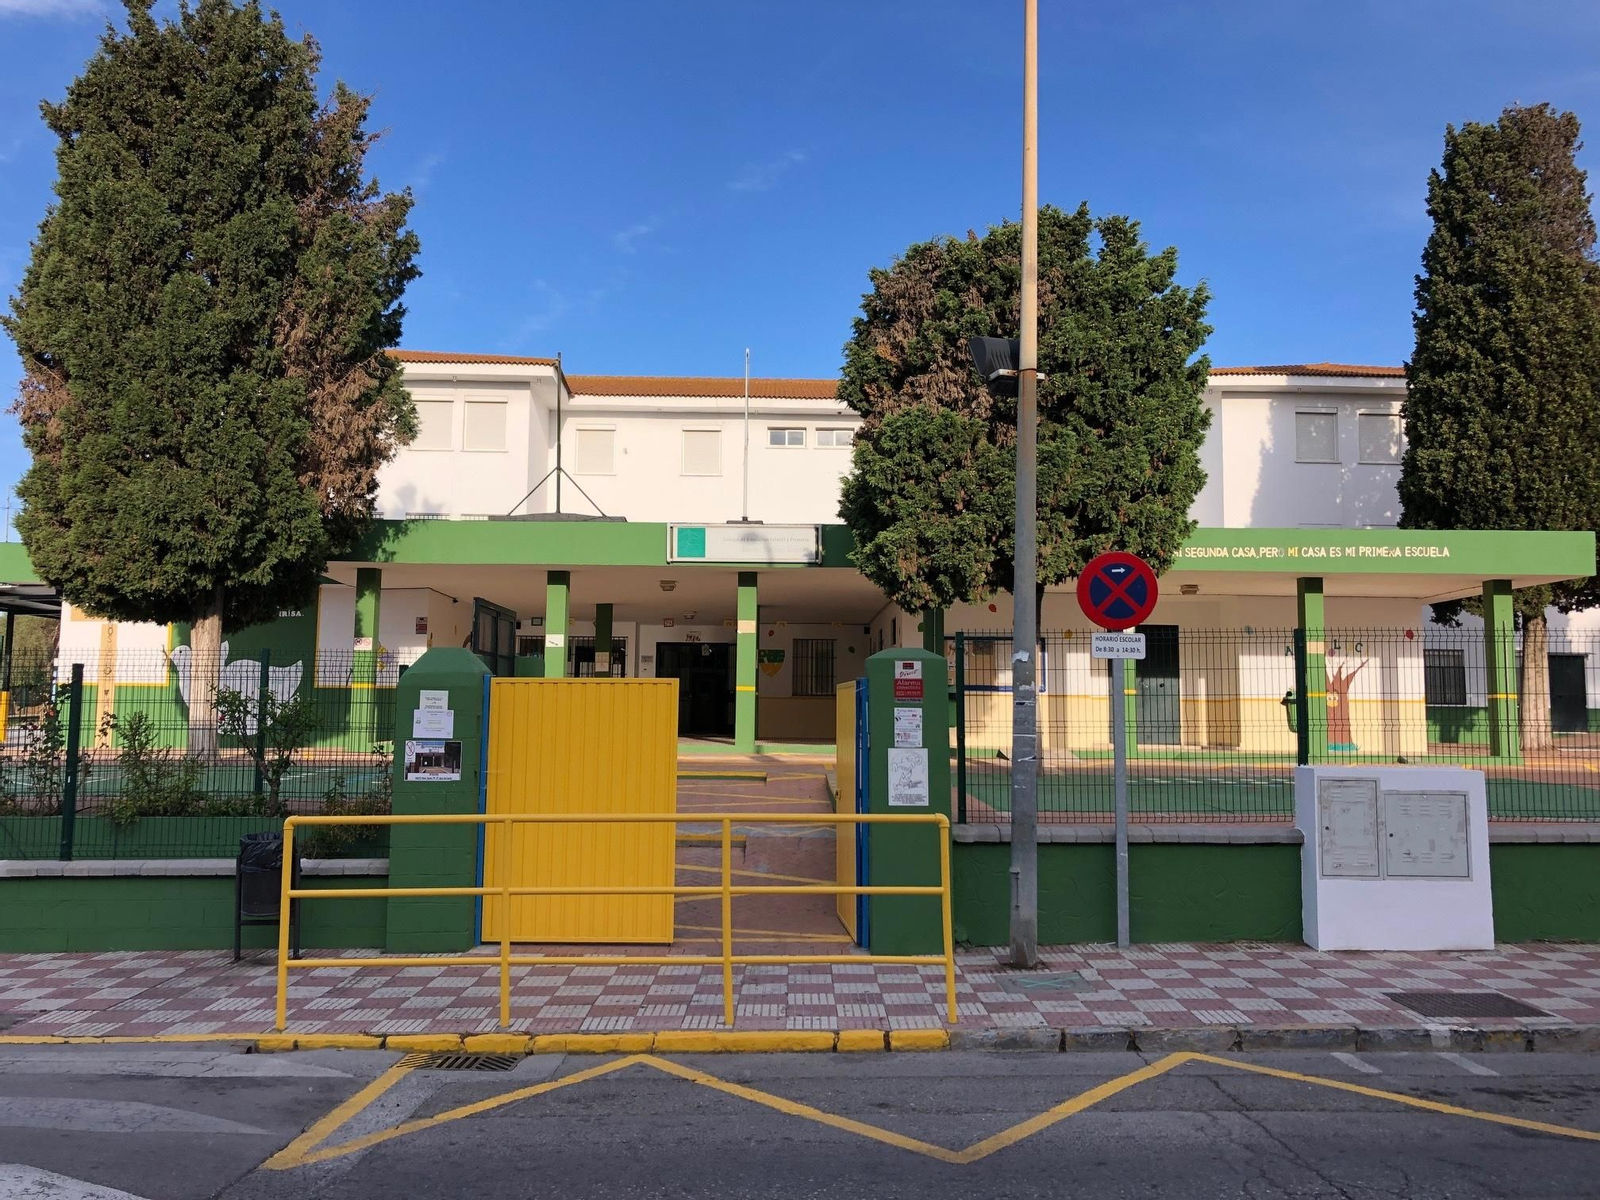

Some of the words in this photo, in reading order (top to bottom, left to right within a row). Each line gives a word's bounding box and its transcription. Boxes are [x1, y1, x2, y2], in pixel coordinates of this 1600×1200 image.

[1185, 547, 1229, 558] SEGUNDA
[1288, 547, 1299, 557] MI
[1301, 547, 1327, 557] CASA
[1330, 547, 1342, 557] ES
[1345, 547, 1356, 557] MI
[1359, 547, 1402, 558] PRIMERA
[1405, 547, 1450, 558] ESCUELA
